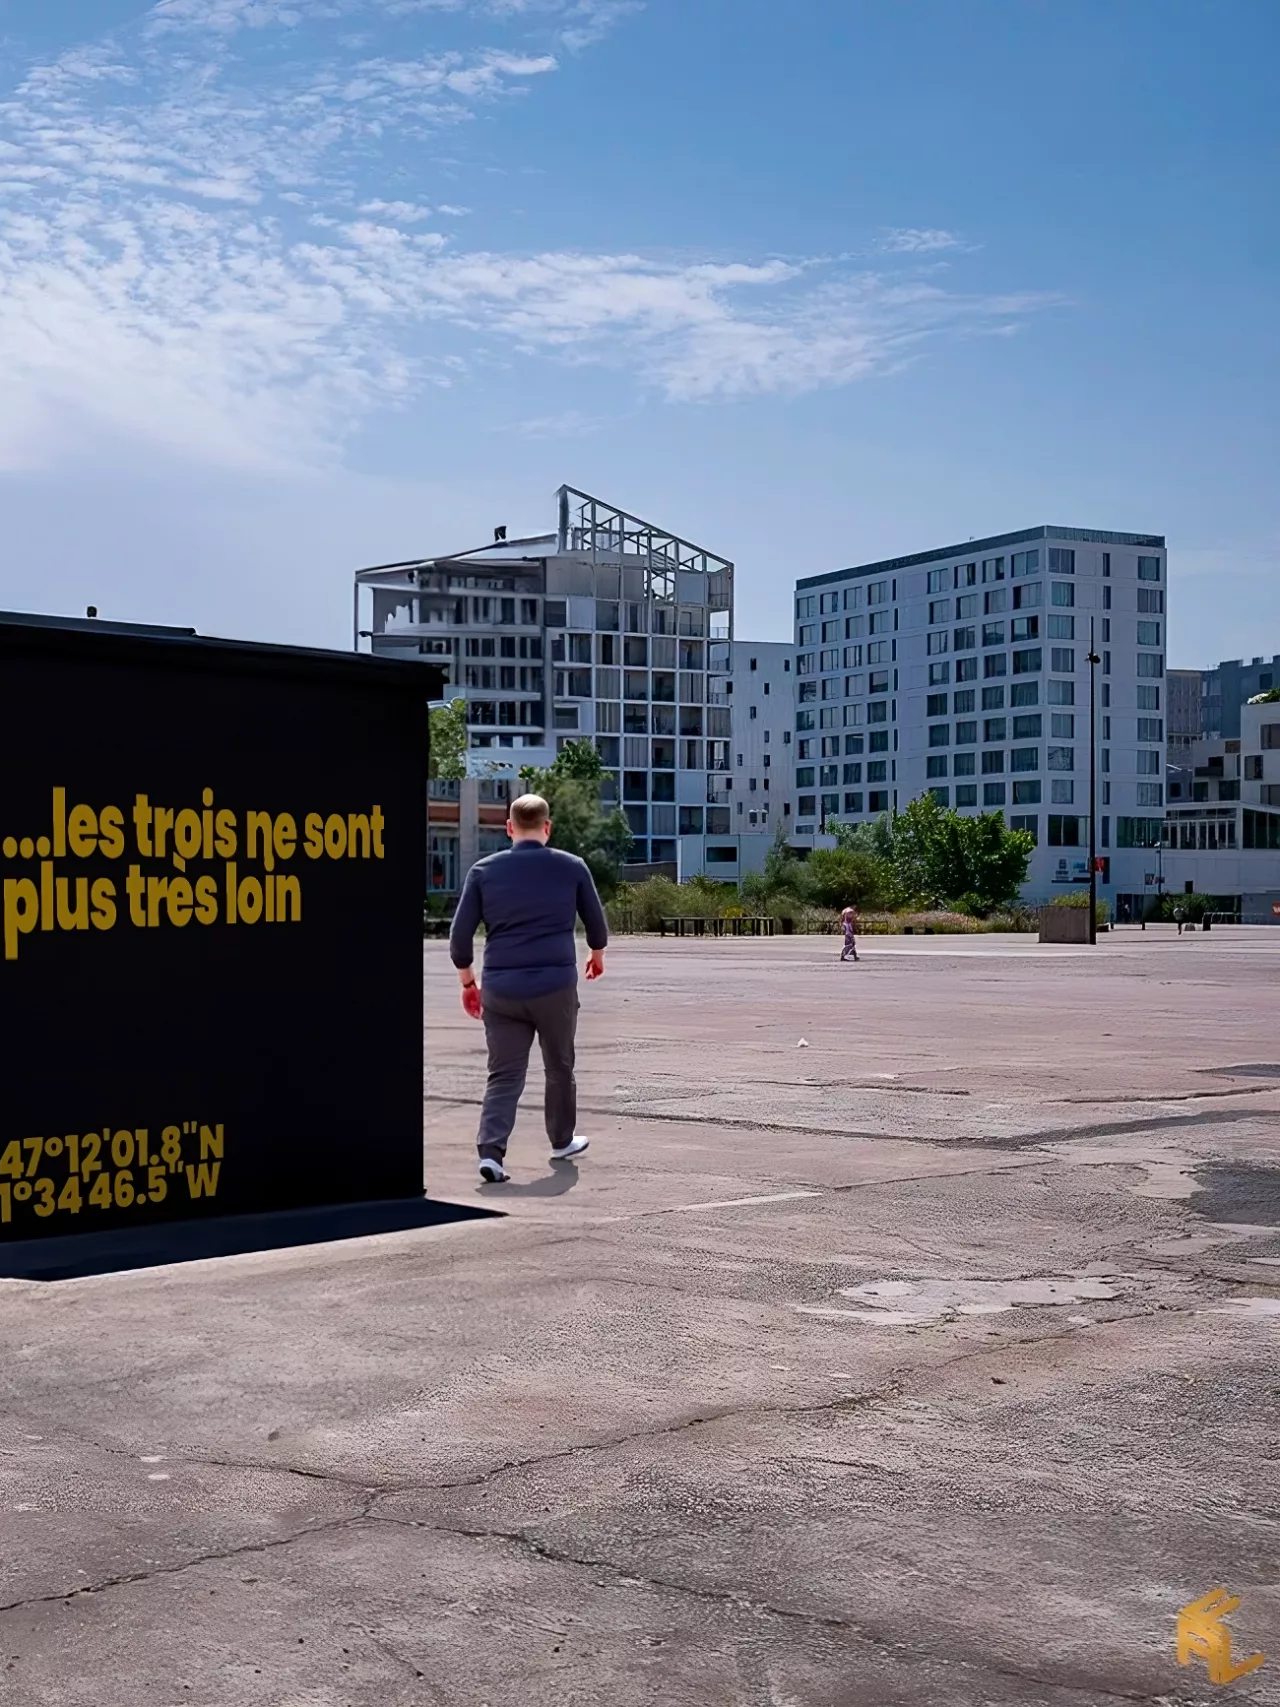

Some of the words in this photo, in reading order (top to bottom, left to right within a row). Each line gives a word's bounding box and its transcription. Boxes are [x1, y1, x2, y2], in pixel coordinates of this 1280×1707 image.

[132, 786, 238, 860] trois
[246, 809, 298, 860] ne
[303, 804, 385, 860] sont
[3, 861, 118, 961] plus
[125, 856, 219, 928] très
[225, 858, 302, 926] loin
